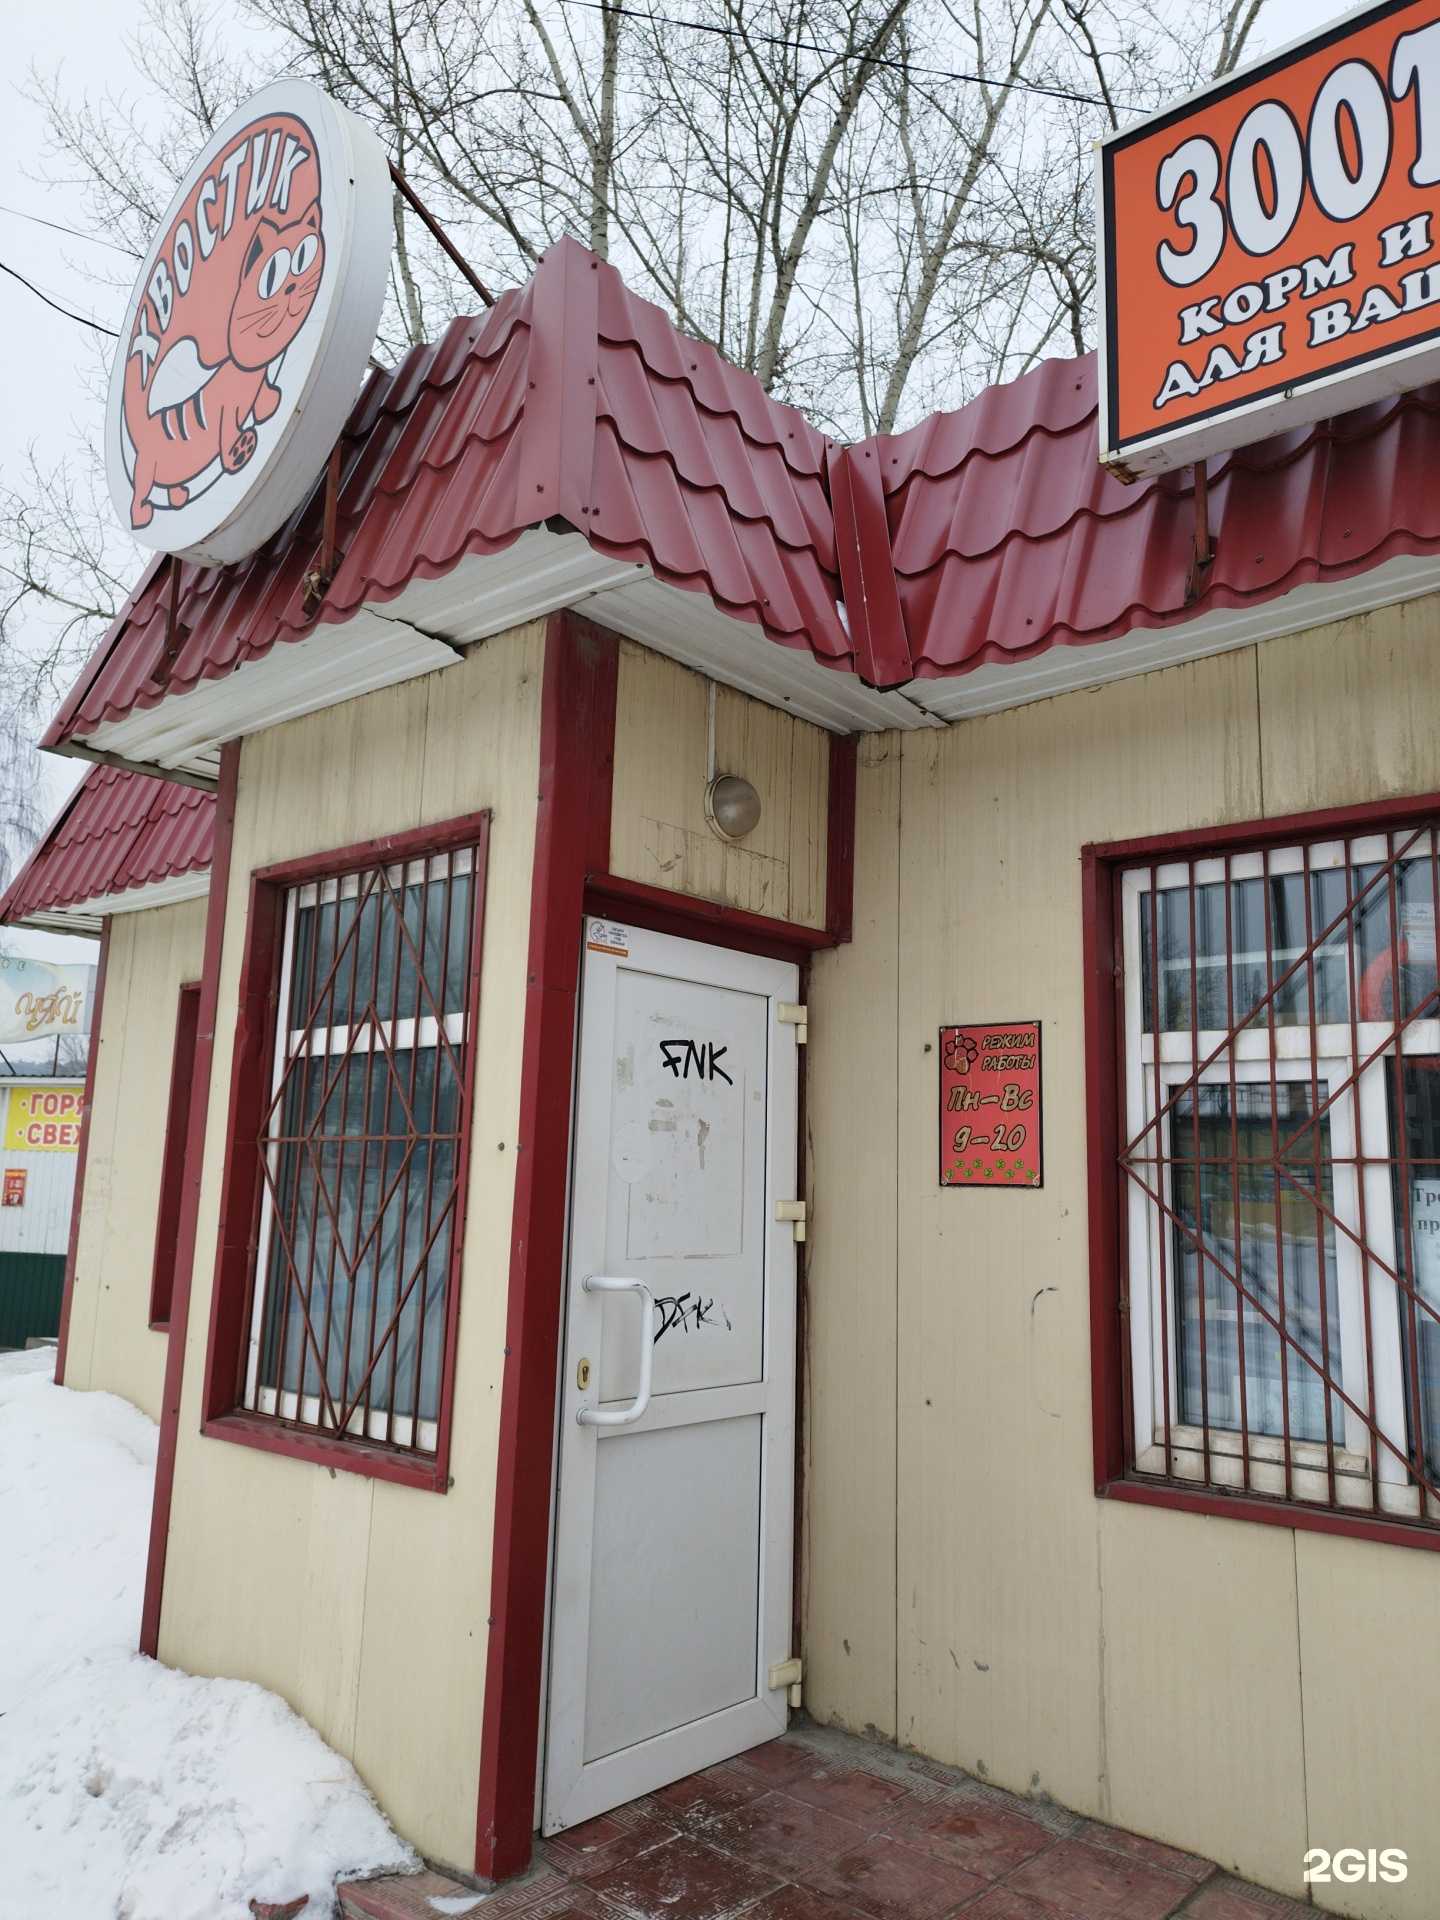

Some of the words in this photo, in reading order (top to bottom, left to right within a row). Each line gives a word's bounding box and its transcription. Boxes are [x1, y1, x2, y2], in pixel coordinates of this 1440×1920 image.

[128, 127, 310, 390] ХВОСТИК
[1178, 243, 1355, 345] КОРМ
[1377, 211, 1434, 269] И
[1153, 322, 1286, 409] ДЛЯ
[659, 1039, 733, 1086] FNK
[981, 1053, 1036, 1072] РАБОТЫ
[982, 1033, 1035, 1049] РЕЖИМ
[952, 1124, 1027, 1152] 9-20
